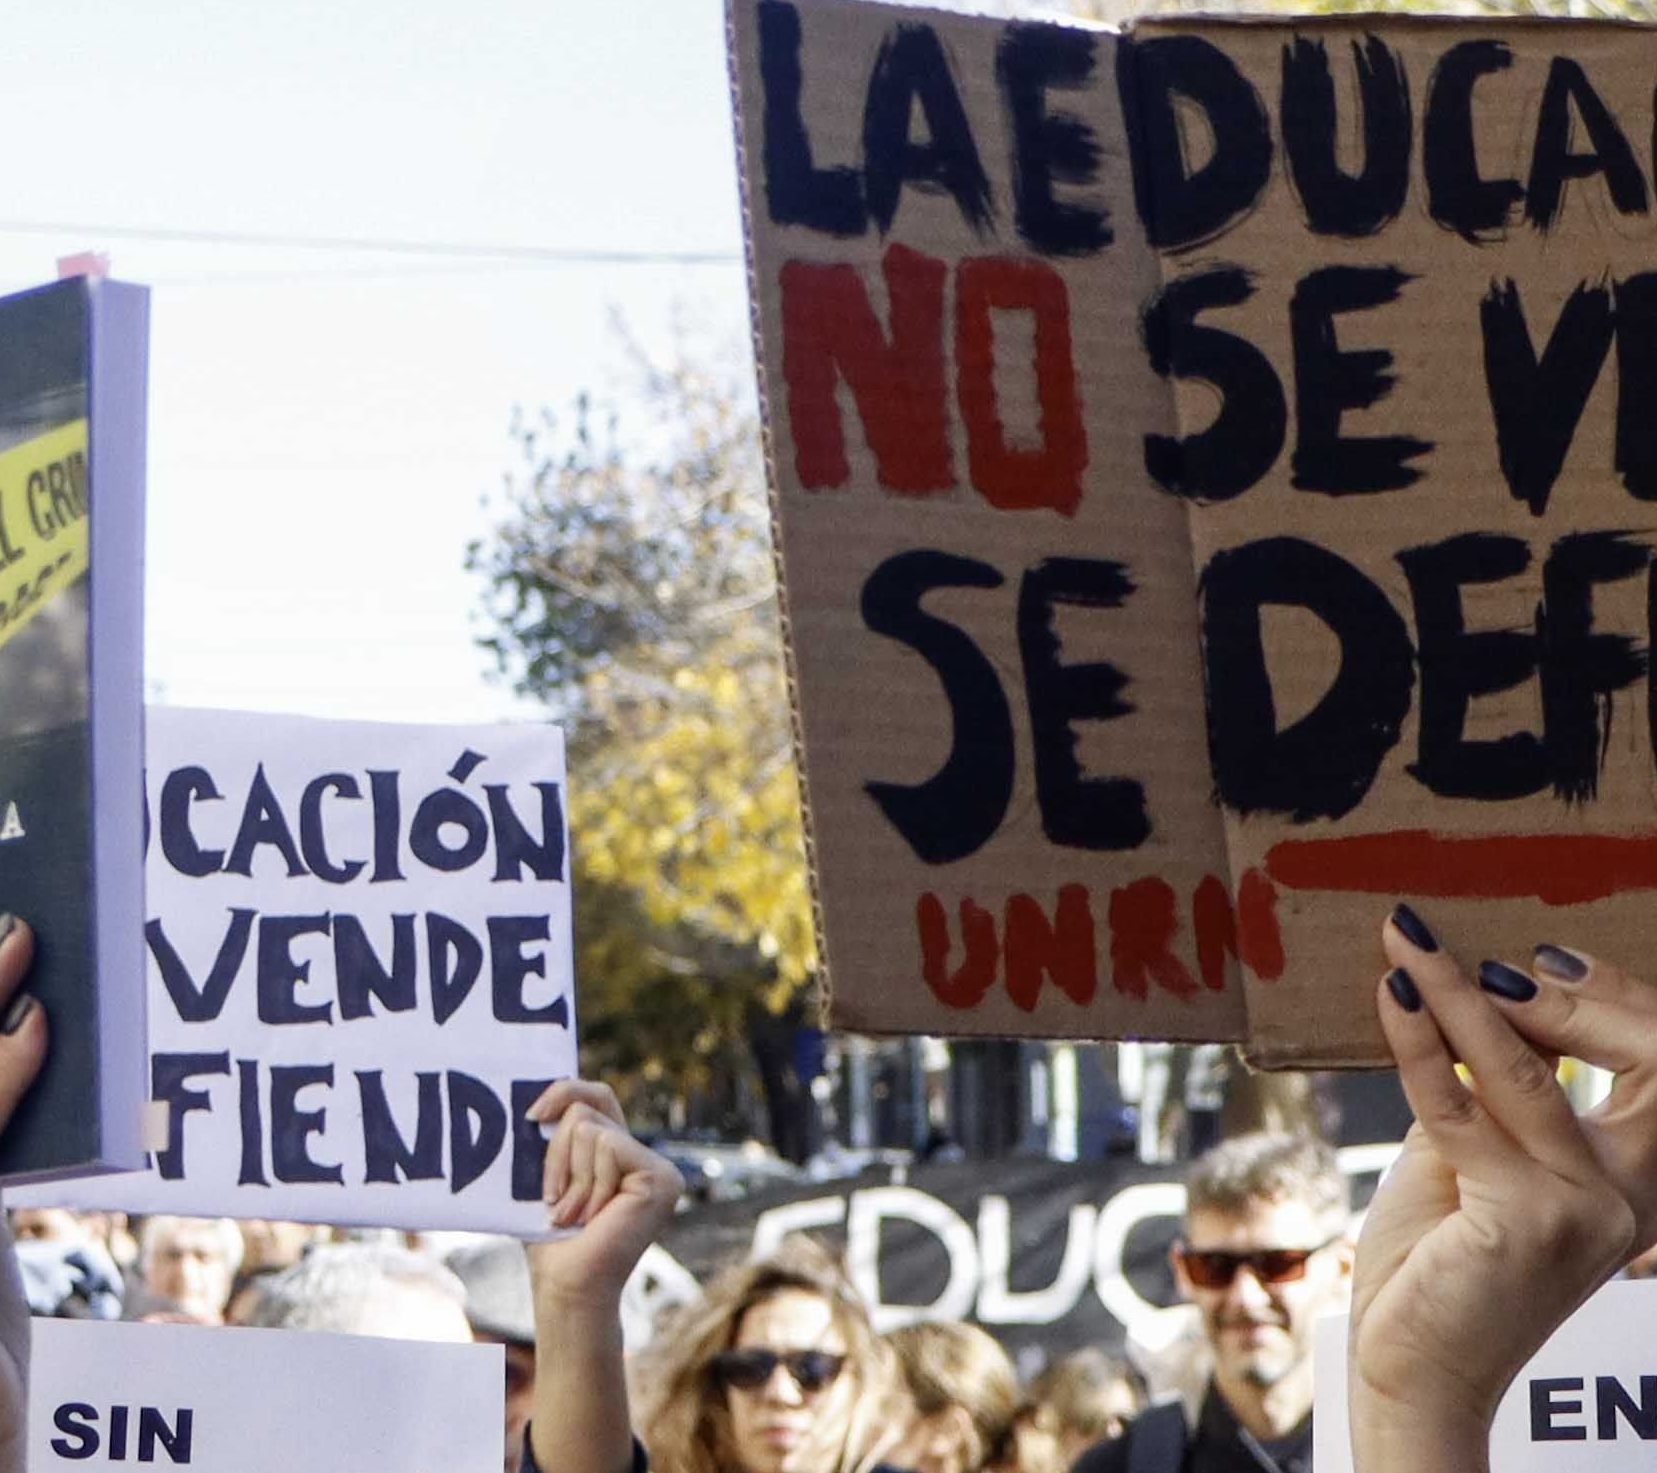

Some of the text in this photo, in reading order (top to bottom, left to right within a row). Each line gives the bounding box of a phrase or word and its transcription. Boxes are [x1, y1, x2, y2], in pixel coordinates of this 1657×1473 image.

[780, 242, 1088, 518] NO
[1143, 264, 1436, 508] SE
[860, 548, 1152, 867] SE
[145, 748, 565, 885] CACIÓN
[144, 906, 569, 1030] VENDE
[915, 867, 1288, 1012] UNRN
[147, 1049, 564, 1202] FIENDE
[49, 1402, 195, 1465] SIN
